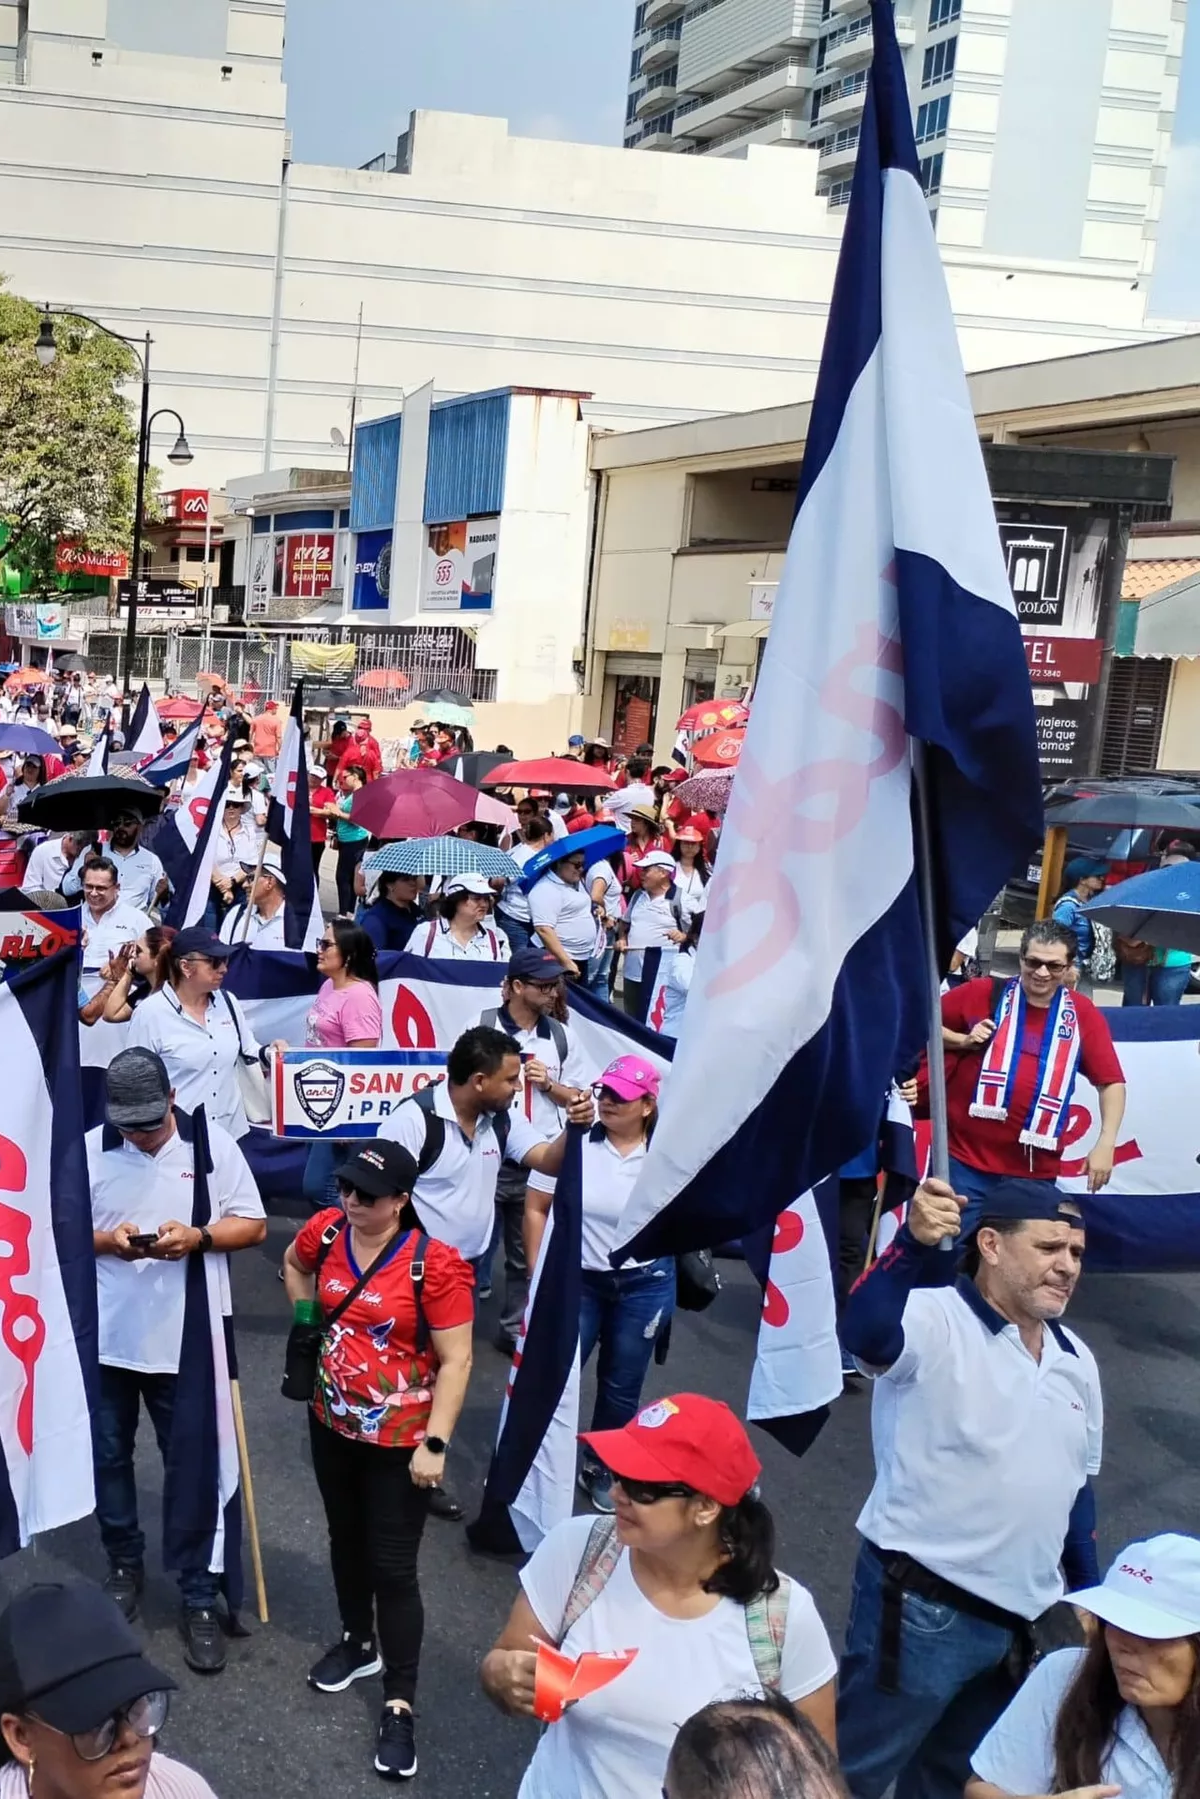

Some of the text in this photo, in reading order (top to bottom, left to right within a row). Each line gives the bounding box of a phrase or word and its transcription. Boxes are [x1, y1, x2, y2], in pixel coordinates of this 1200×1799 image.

[469, 533, 497, 544] RADIADOR
[87, 555, 121, 567] Mutual
[1018, 601, 1058, 615] COLÓN
[1042, 728, 1076, 741] lo que
[350, 1072, 404, 1095] SAN
